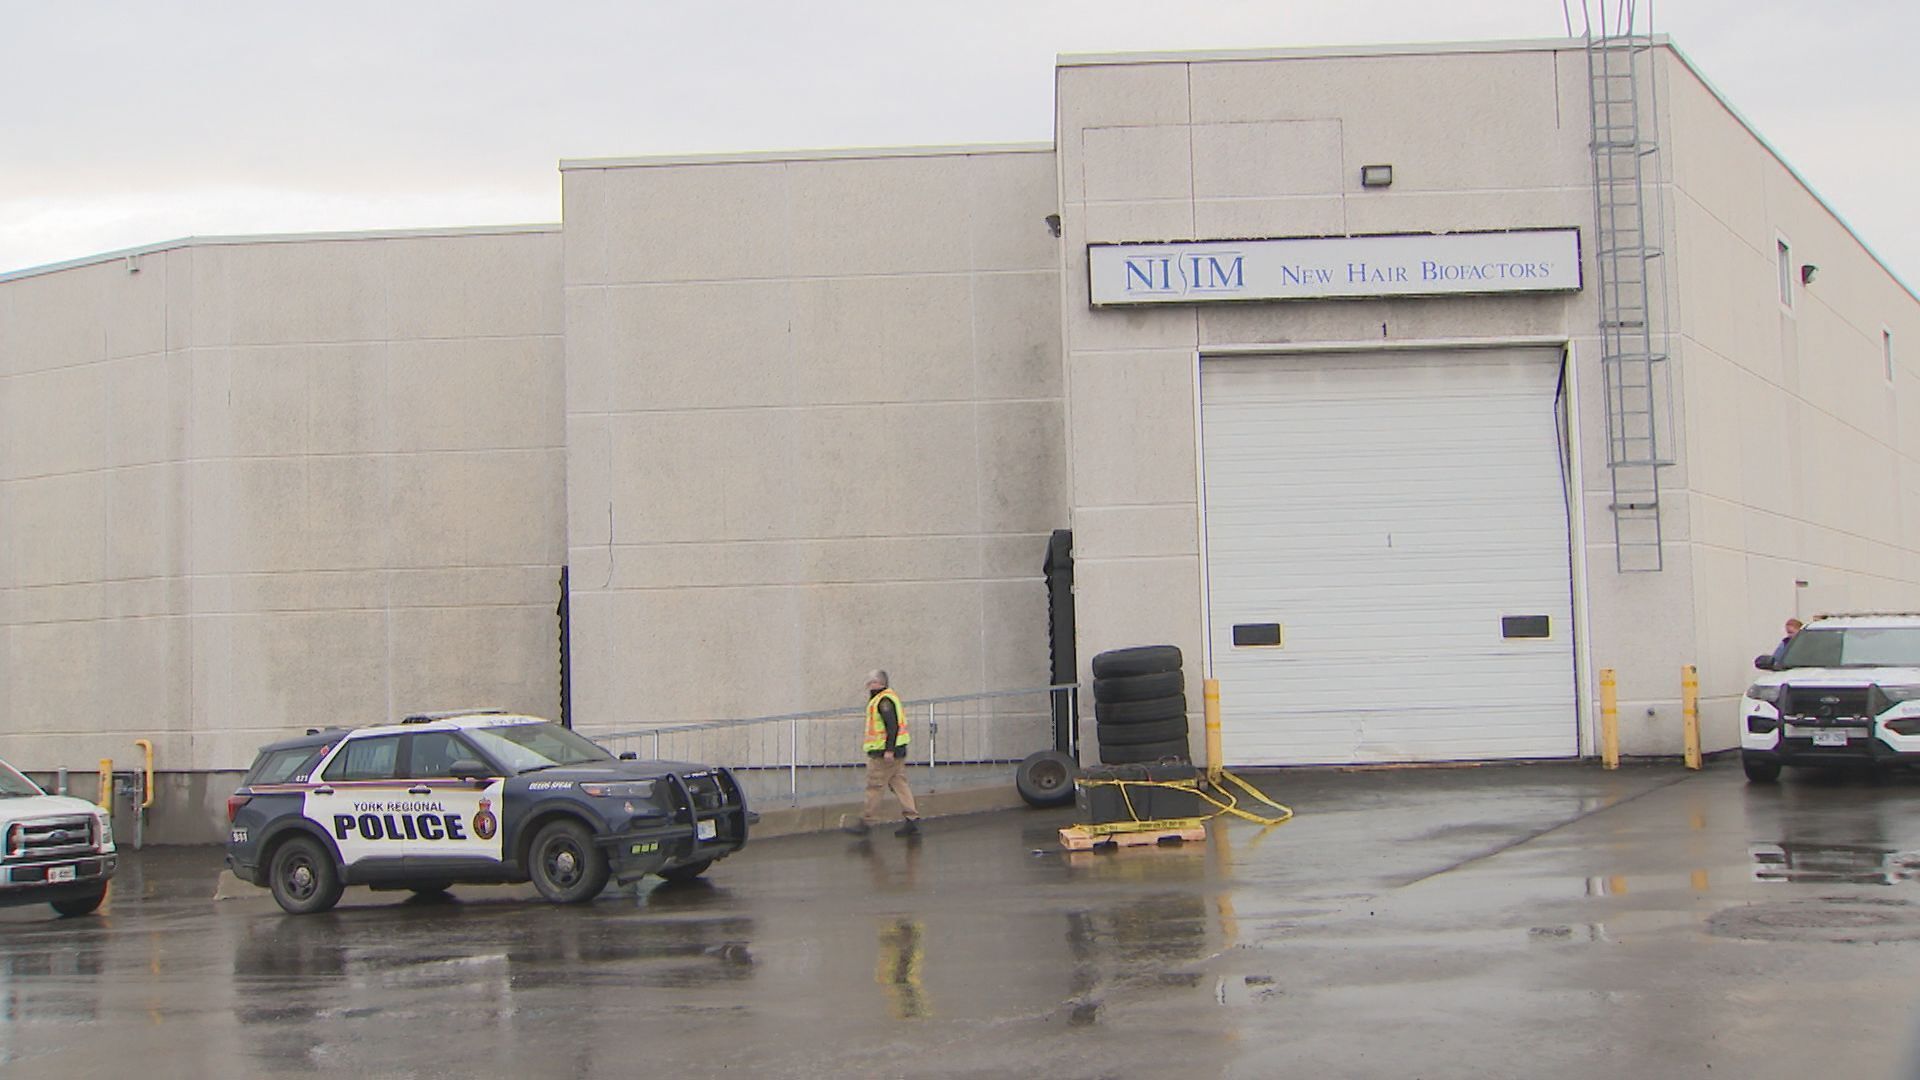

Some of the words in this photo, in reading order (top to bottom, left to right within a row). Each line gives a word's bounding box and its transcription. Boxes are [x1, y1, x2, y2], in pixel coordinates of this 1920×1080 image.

[1124, 250, 1245, 296] NISIM
[1381, 321, 1388, 338] 1
[353, 801, 383, 812] YORK
[387, 801, 444, 812] REGIONAL
[333, 813, 467, 840] POLICE
